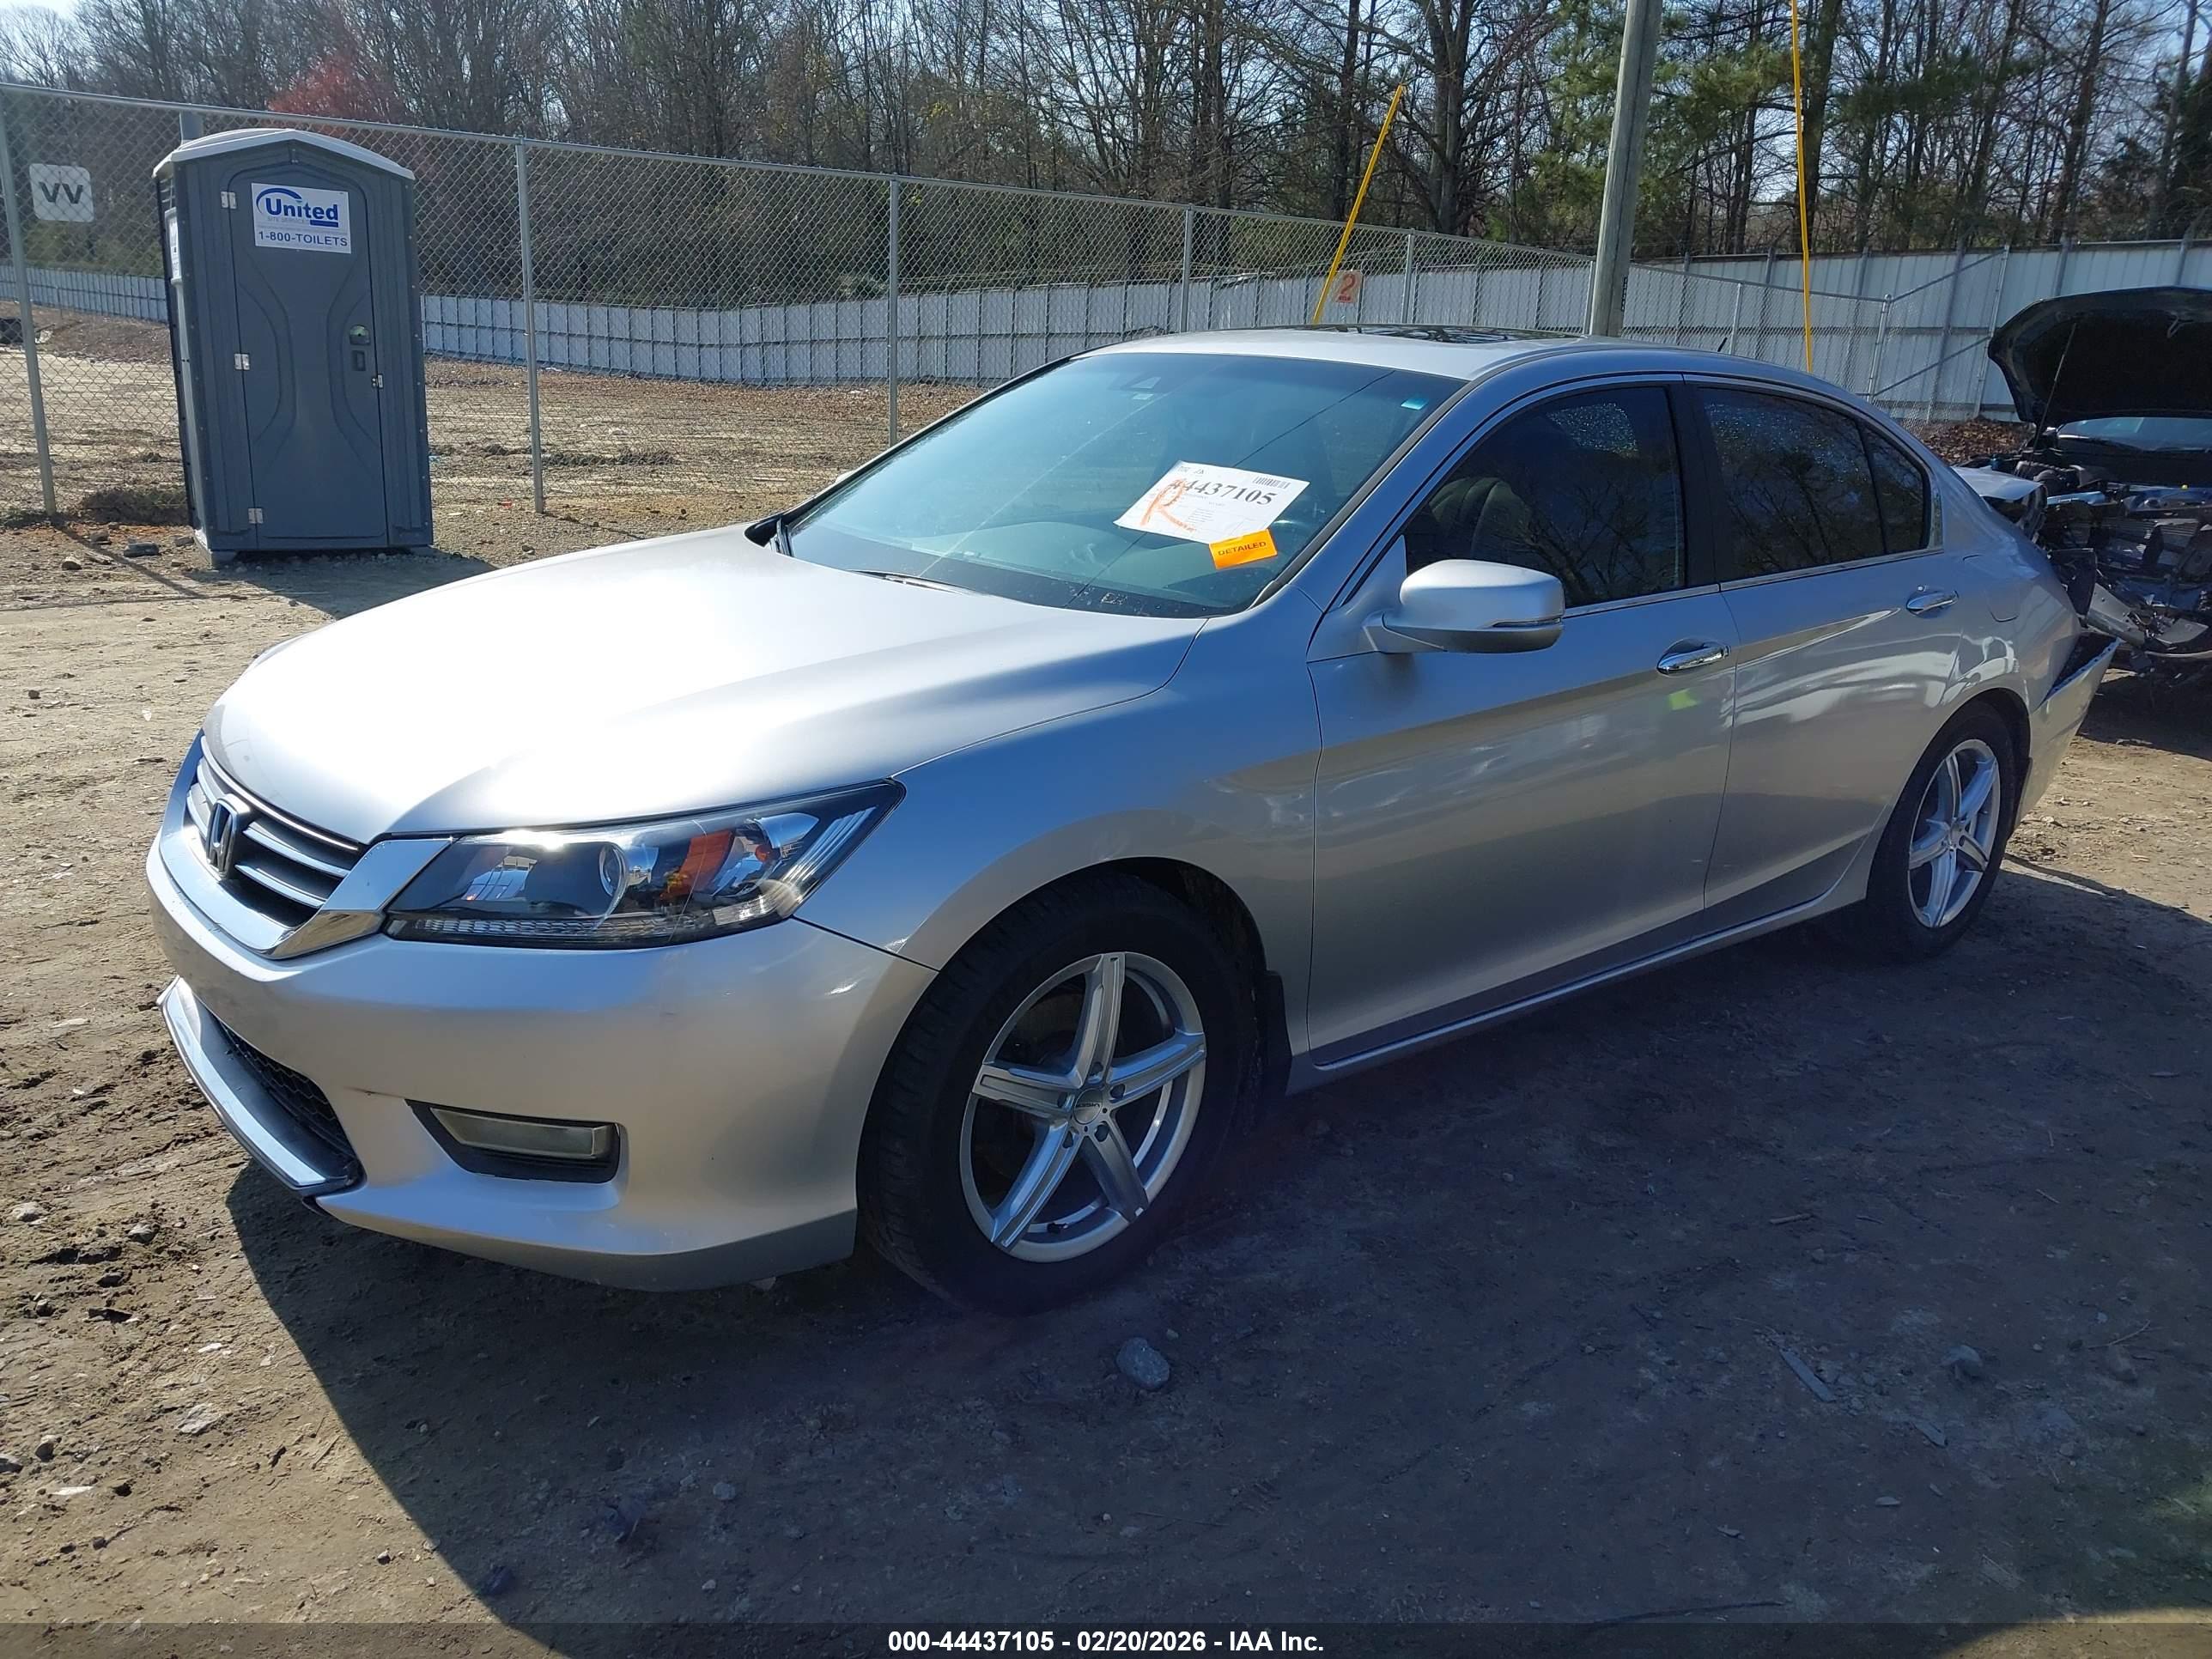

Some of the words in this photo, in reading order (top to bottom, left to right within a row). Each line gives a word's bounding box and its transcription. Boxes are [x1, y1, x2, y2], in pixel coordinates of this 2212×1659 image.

[265, 198, 338, 221] United
[258, 231, 348, 246] 1-800-TOILETS
[1339, 274, 1356, 301] 2
[1218, 541, 1267, 556] DETAILED
